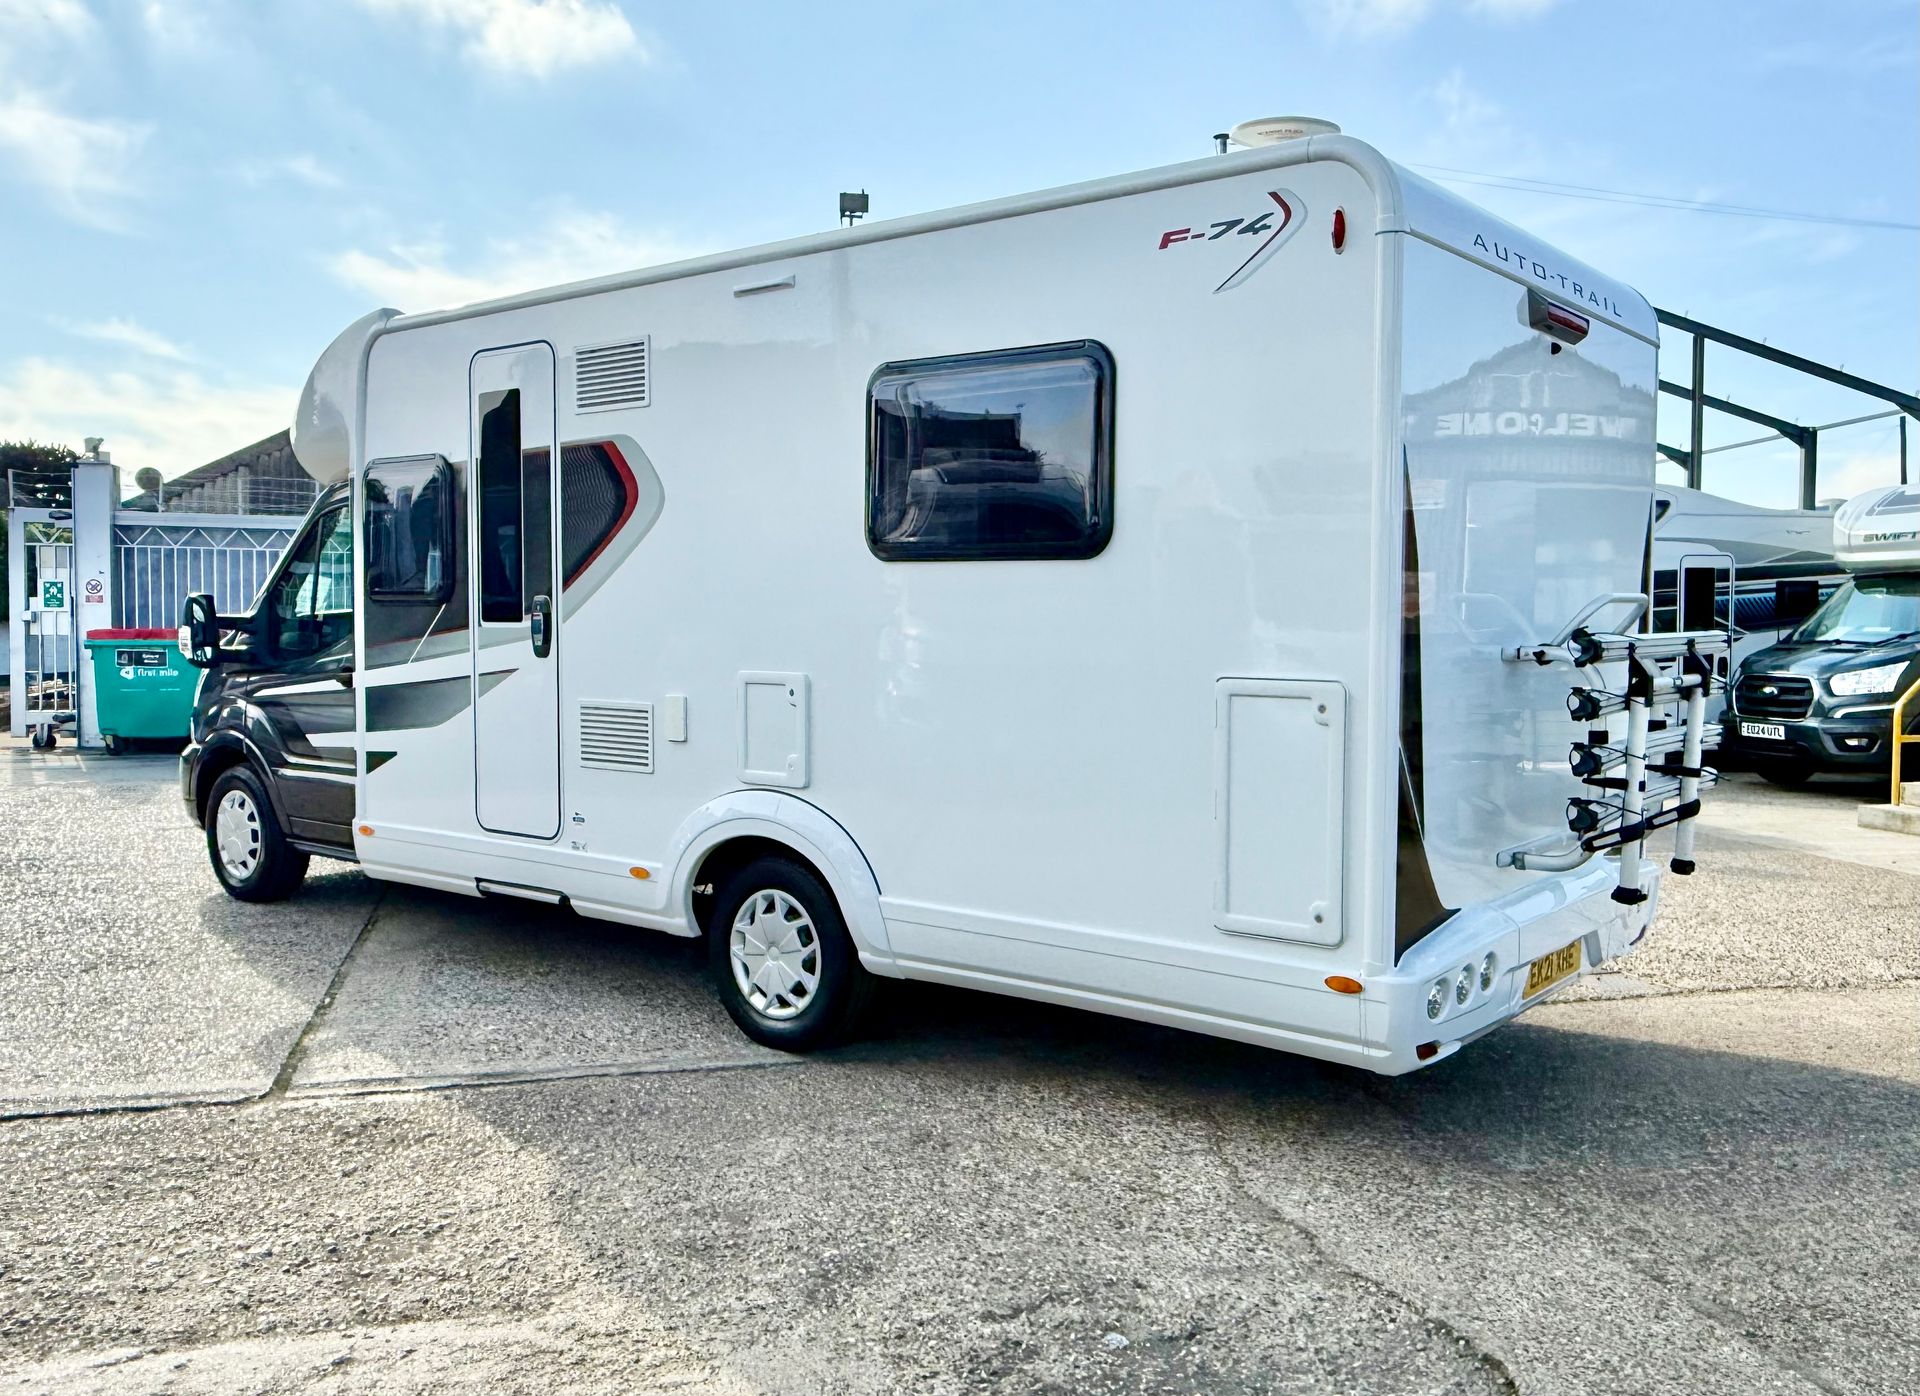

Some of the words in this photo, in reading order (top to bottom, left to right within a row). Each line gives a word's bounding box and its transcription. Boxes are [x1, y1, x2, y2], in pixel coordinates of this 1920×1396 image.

[1158, 211, 1275, 250] F-74
[1472, 232, 1623, 319] AUTO-TRAIL
[1862, 531, 1920, 543] SWIFT
[137, 668, 156, 677] first
[159, 668, 179, 677] mile
[1529, 953, 1553, 990] EK21
